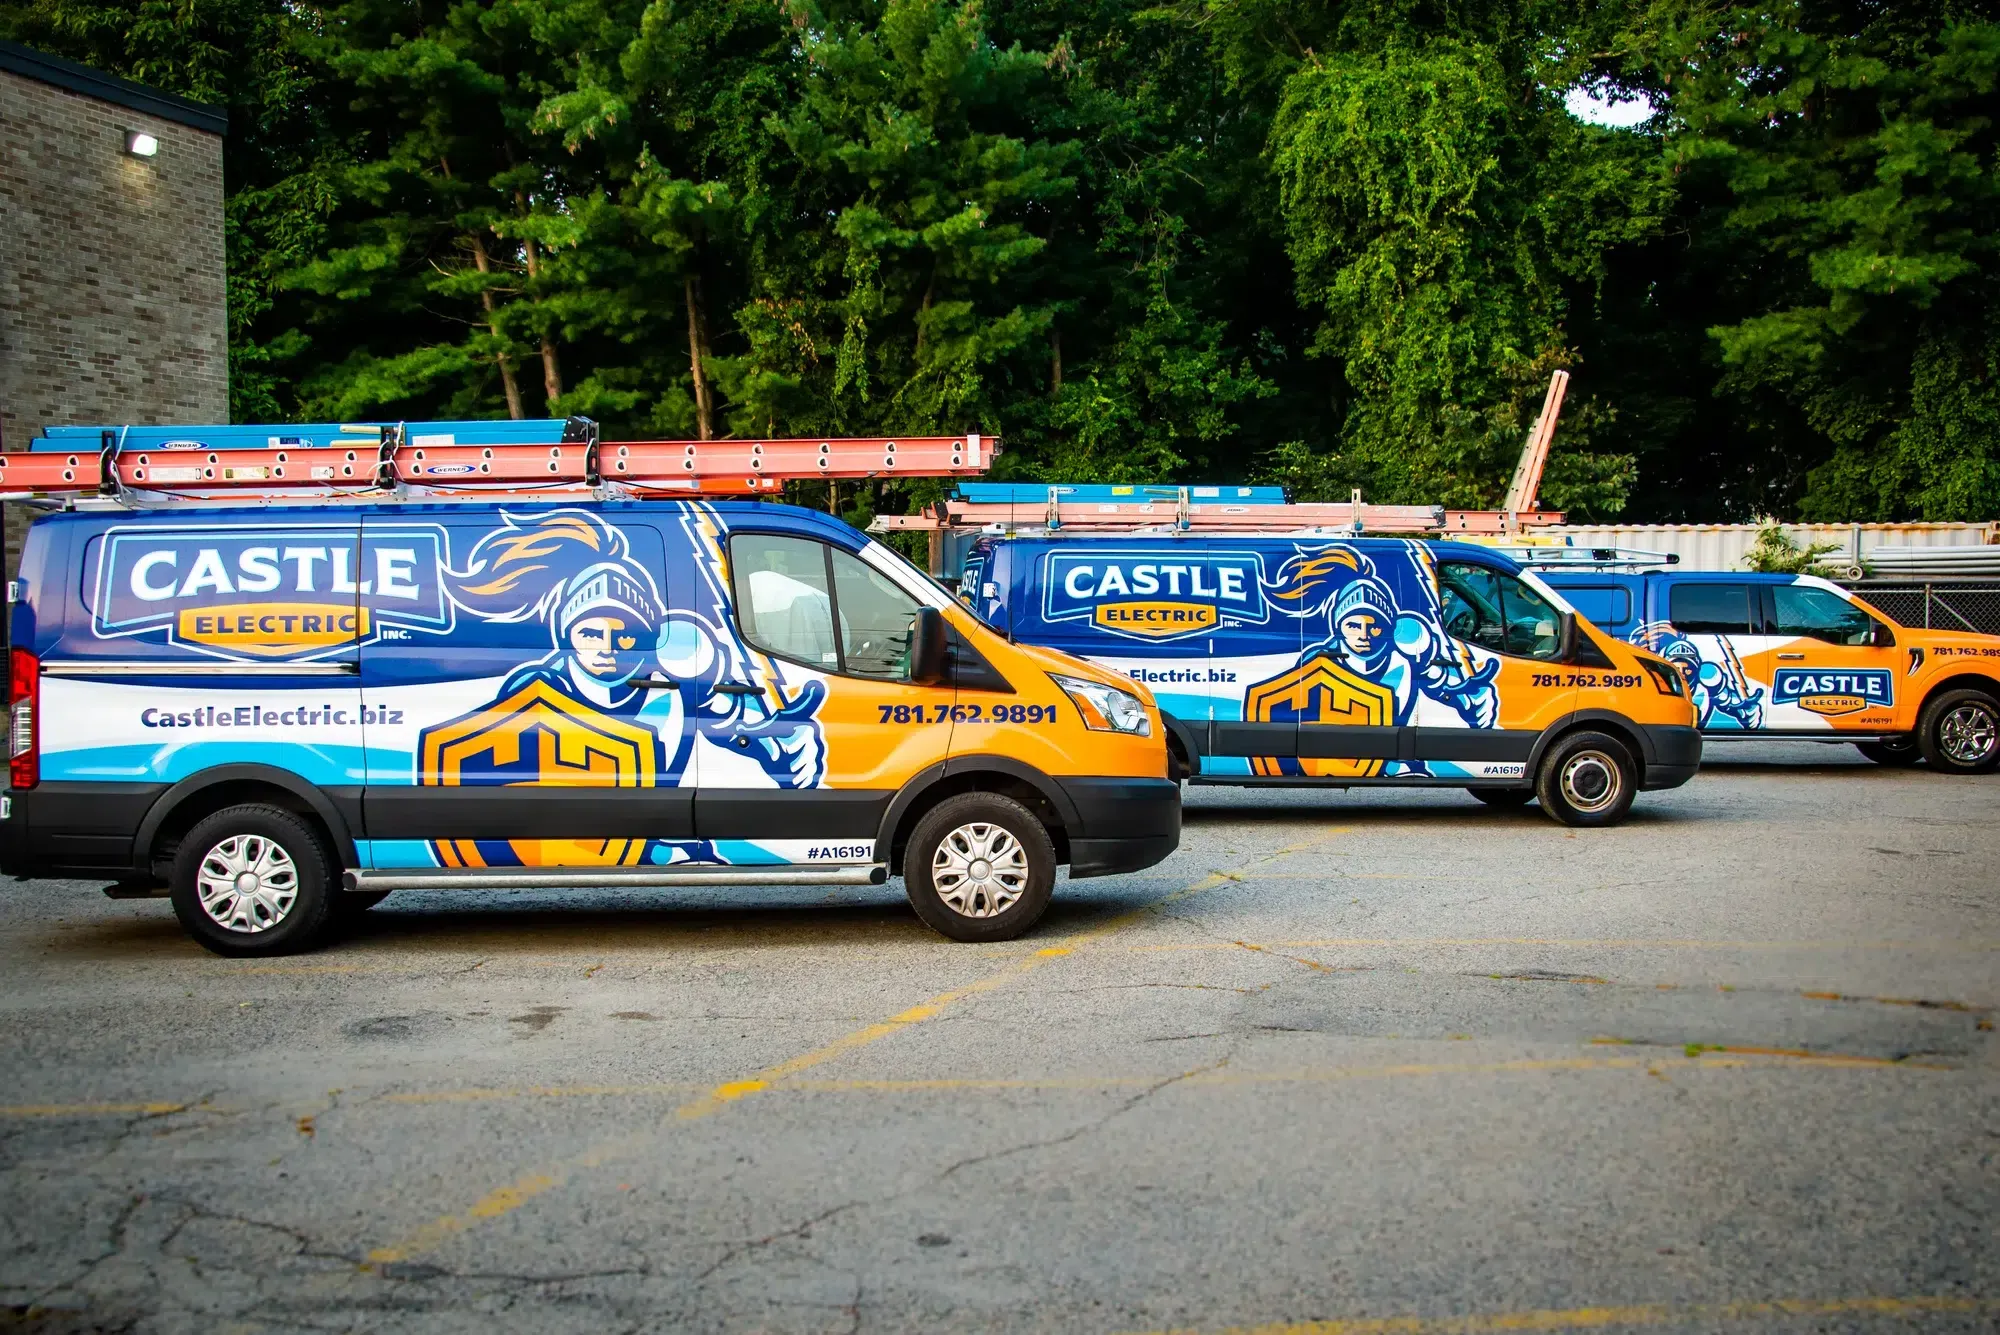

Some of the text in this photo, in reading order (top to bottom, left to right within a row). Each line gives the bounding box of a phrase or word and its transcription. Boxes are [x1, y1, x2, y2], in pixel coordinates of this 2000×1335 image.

[130, 547, 420, 601] CASTLE
[1064, 564, 1247, 602] CASTLE
[1106, 609, 1207, 622] ELECTRIC
[195, 614, 358, 635] ELECTRIC
[1224, 620, 1243, 628] INC.
[383, 629, 412, 640] INC.
[1125, 669, 1237, 683] Electric.biz
[1531, 674, 1642, 688] 781.762.9891
[1783, 675, 1882, 696] CASTLE
[141, 704, 404, 728] CastleElectric.biz
[878, 704, 1057, 724] 781.762.9891
[1860, 717, 1893, 725] #A16191
[1483, 766, 1524, 775] #A16191
[807, 846, 872, 859] #A16191
